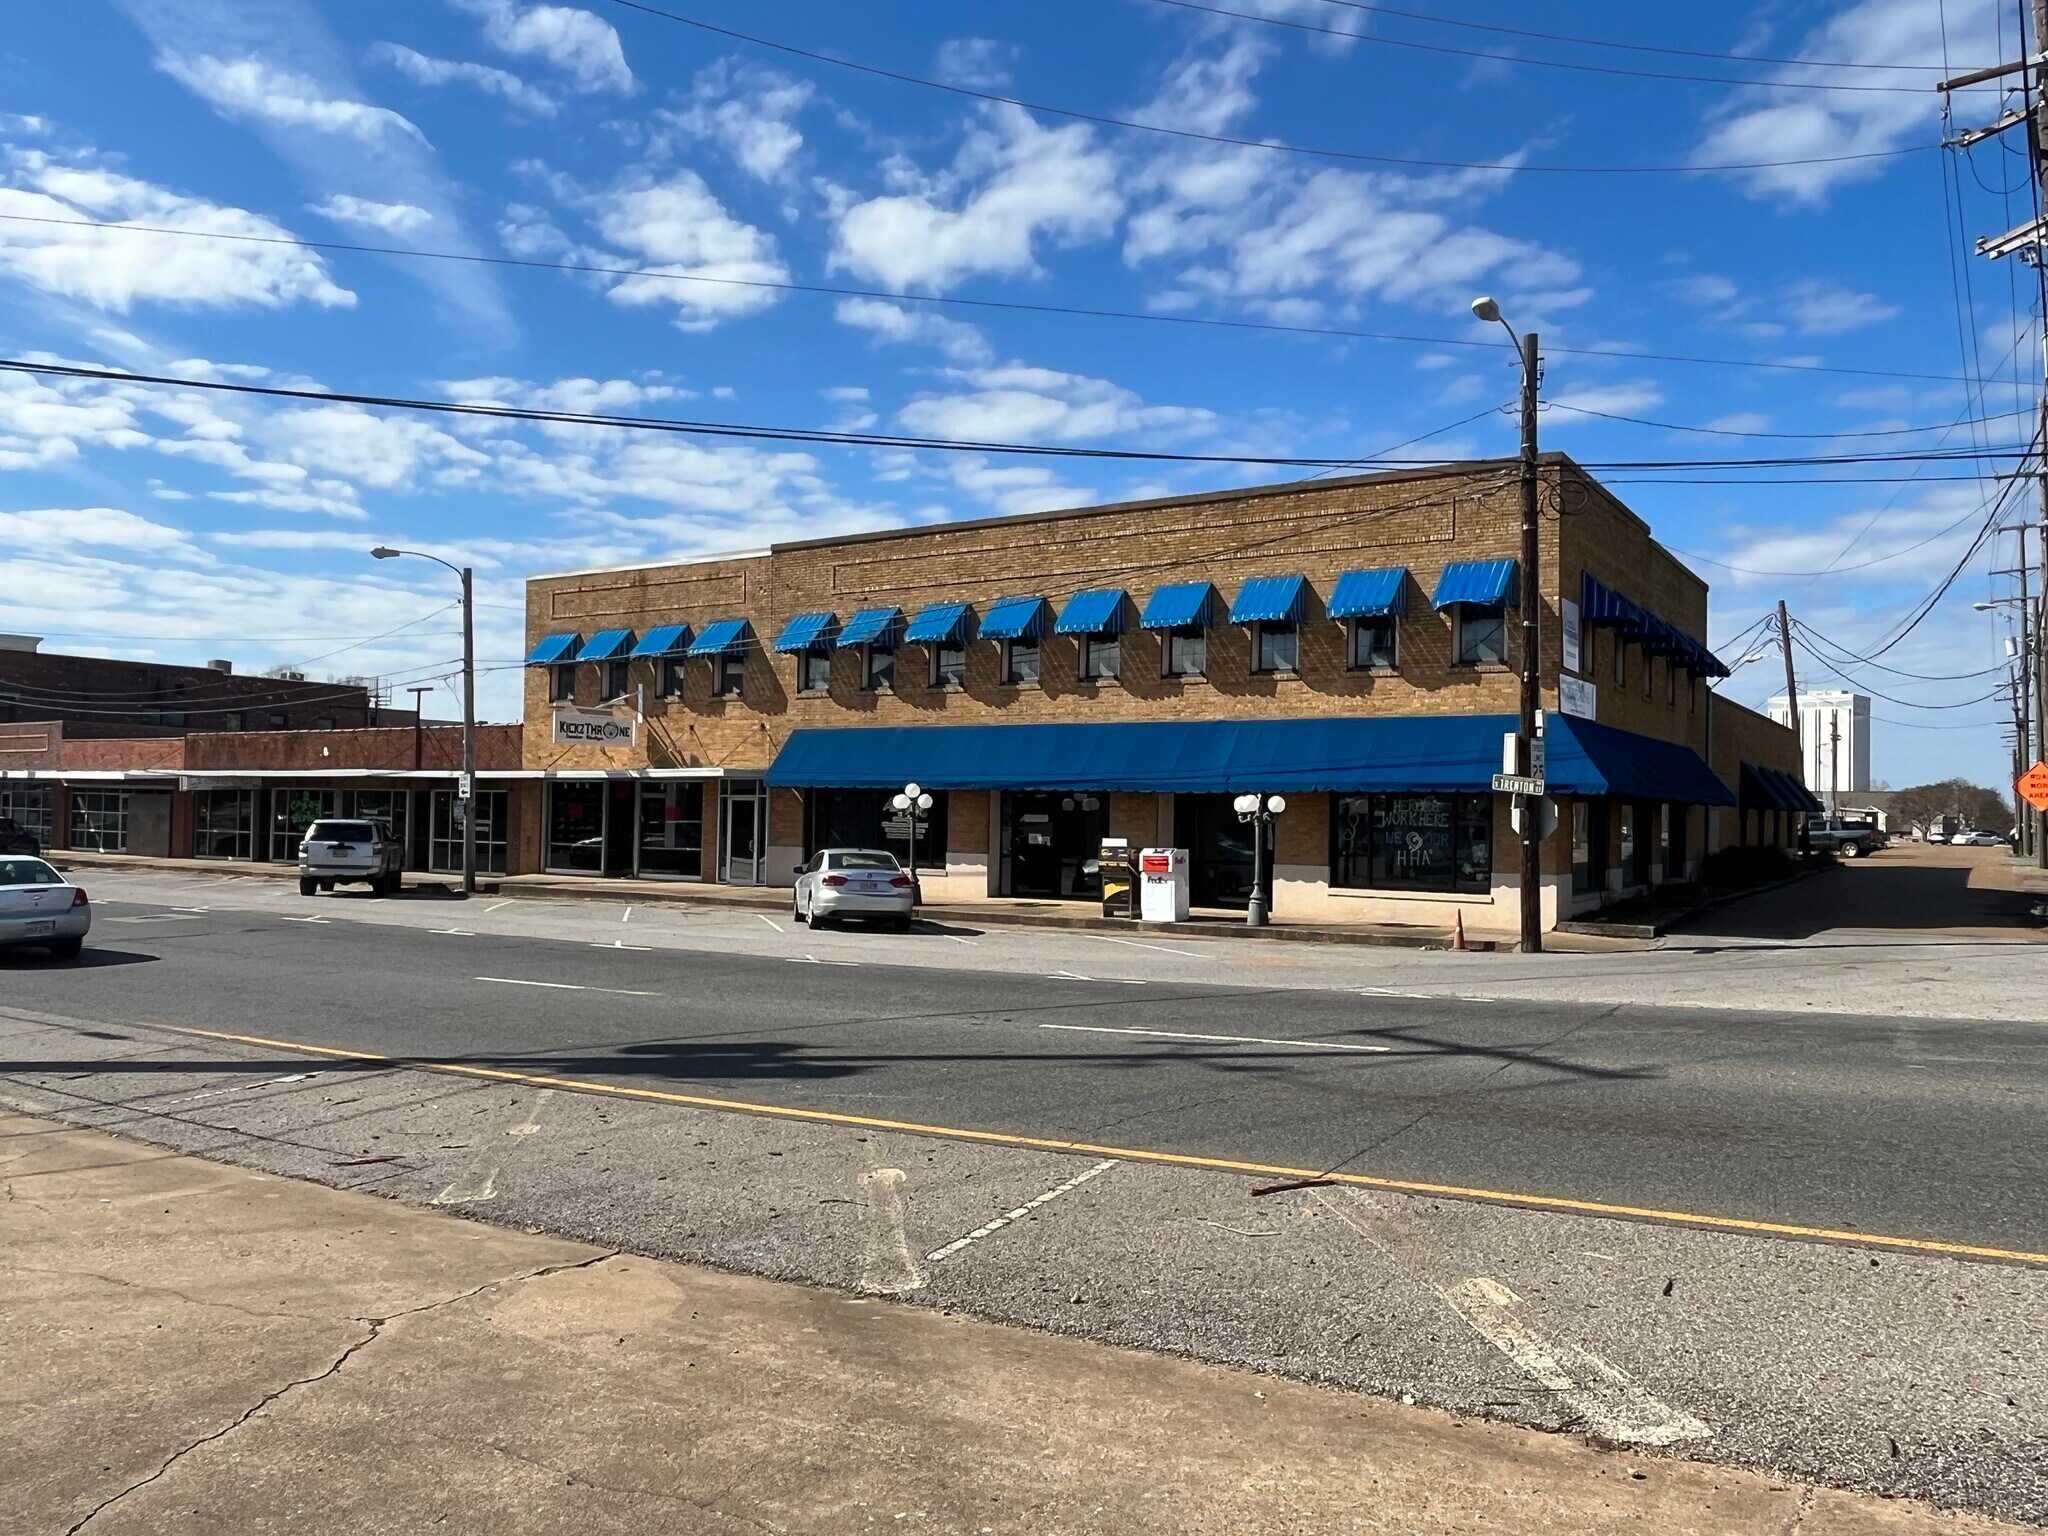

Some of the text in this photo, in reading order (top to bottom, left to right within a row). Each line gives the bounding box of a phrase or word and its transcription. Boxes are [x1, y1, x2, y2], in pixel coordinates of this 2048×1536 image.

[1532, 765, 1544, 780] 25
[1500, 779, 1534, 792] TRENTON
[1419, 811, 1449, 828] HERE
[1385, 831, 1403, 845] WE
[1147, 876, 1170, 885] FedEx
